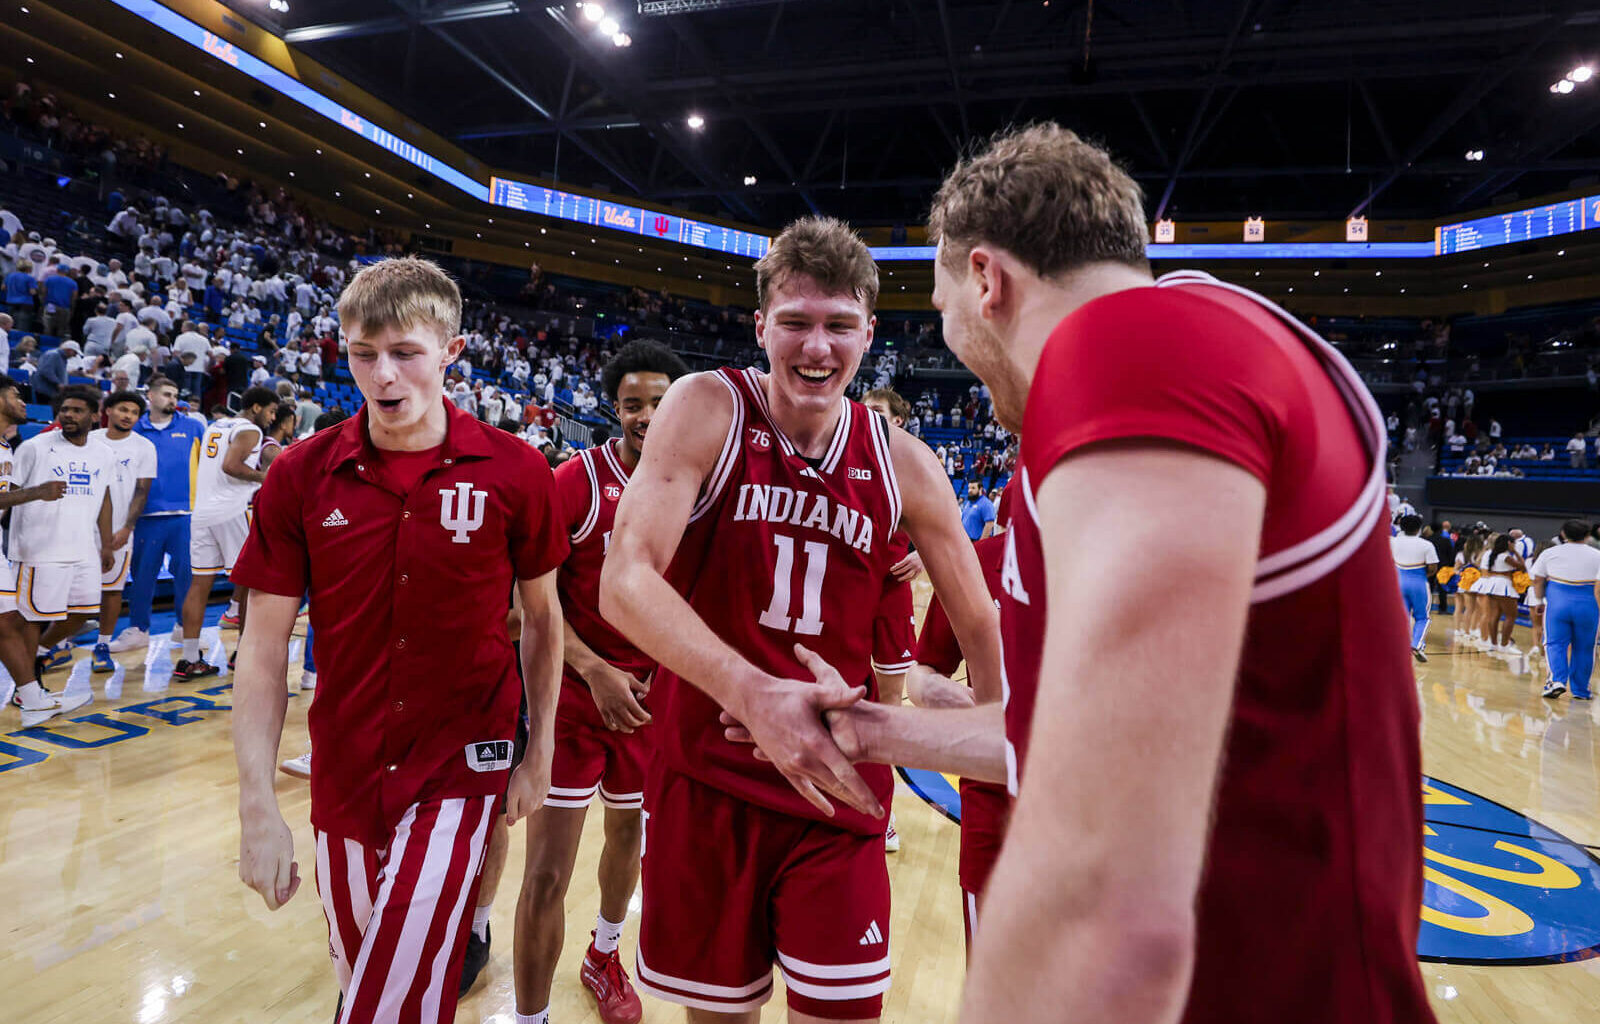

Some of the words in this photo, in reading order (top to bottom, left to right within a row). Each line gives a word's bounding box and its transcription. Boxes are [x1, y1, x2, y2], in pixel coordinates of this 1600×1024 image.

[206, 432, 222, 458] 5
[322, 519, 349, 527] adidas
[733, 483, 873, 555] INDIANA
[758, 533, 830, 636] 11
